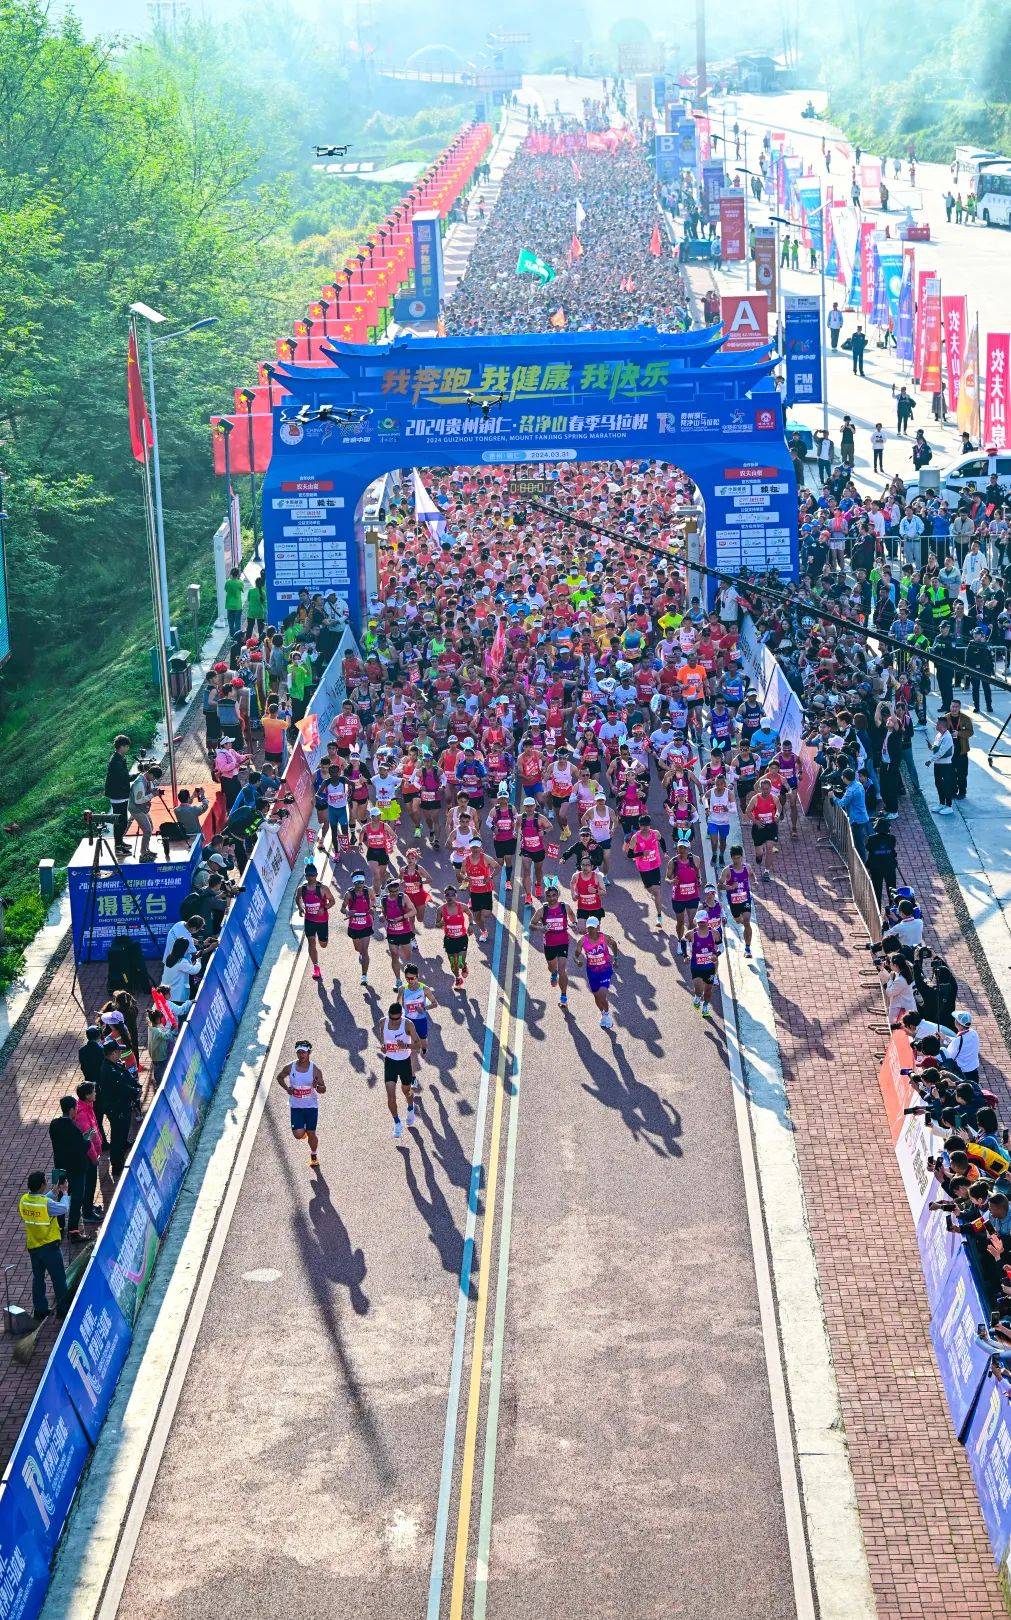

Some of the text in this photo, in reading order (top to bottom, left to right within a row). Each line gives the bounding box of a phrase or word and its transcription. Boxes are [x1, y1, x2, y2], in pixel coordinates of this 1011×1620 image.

[661, 136, 674, 151] B
[730, 300, 760, 331] A
[381, 361, 672, 404] 我奔跑 我健康 我快乐
[794, 374, 813, 384] FM
[990, 348, 1006, 448] 农夫山泉
[478, 435, 507, 443] TONGREN,
[535, 433, 562, 441] FANJING
[97, 893, 167, 916] 摄影台
